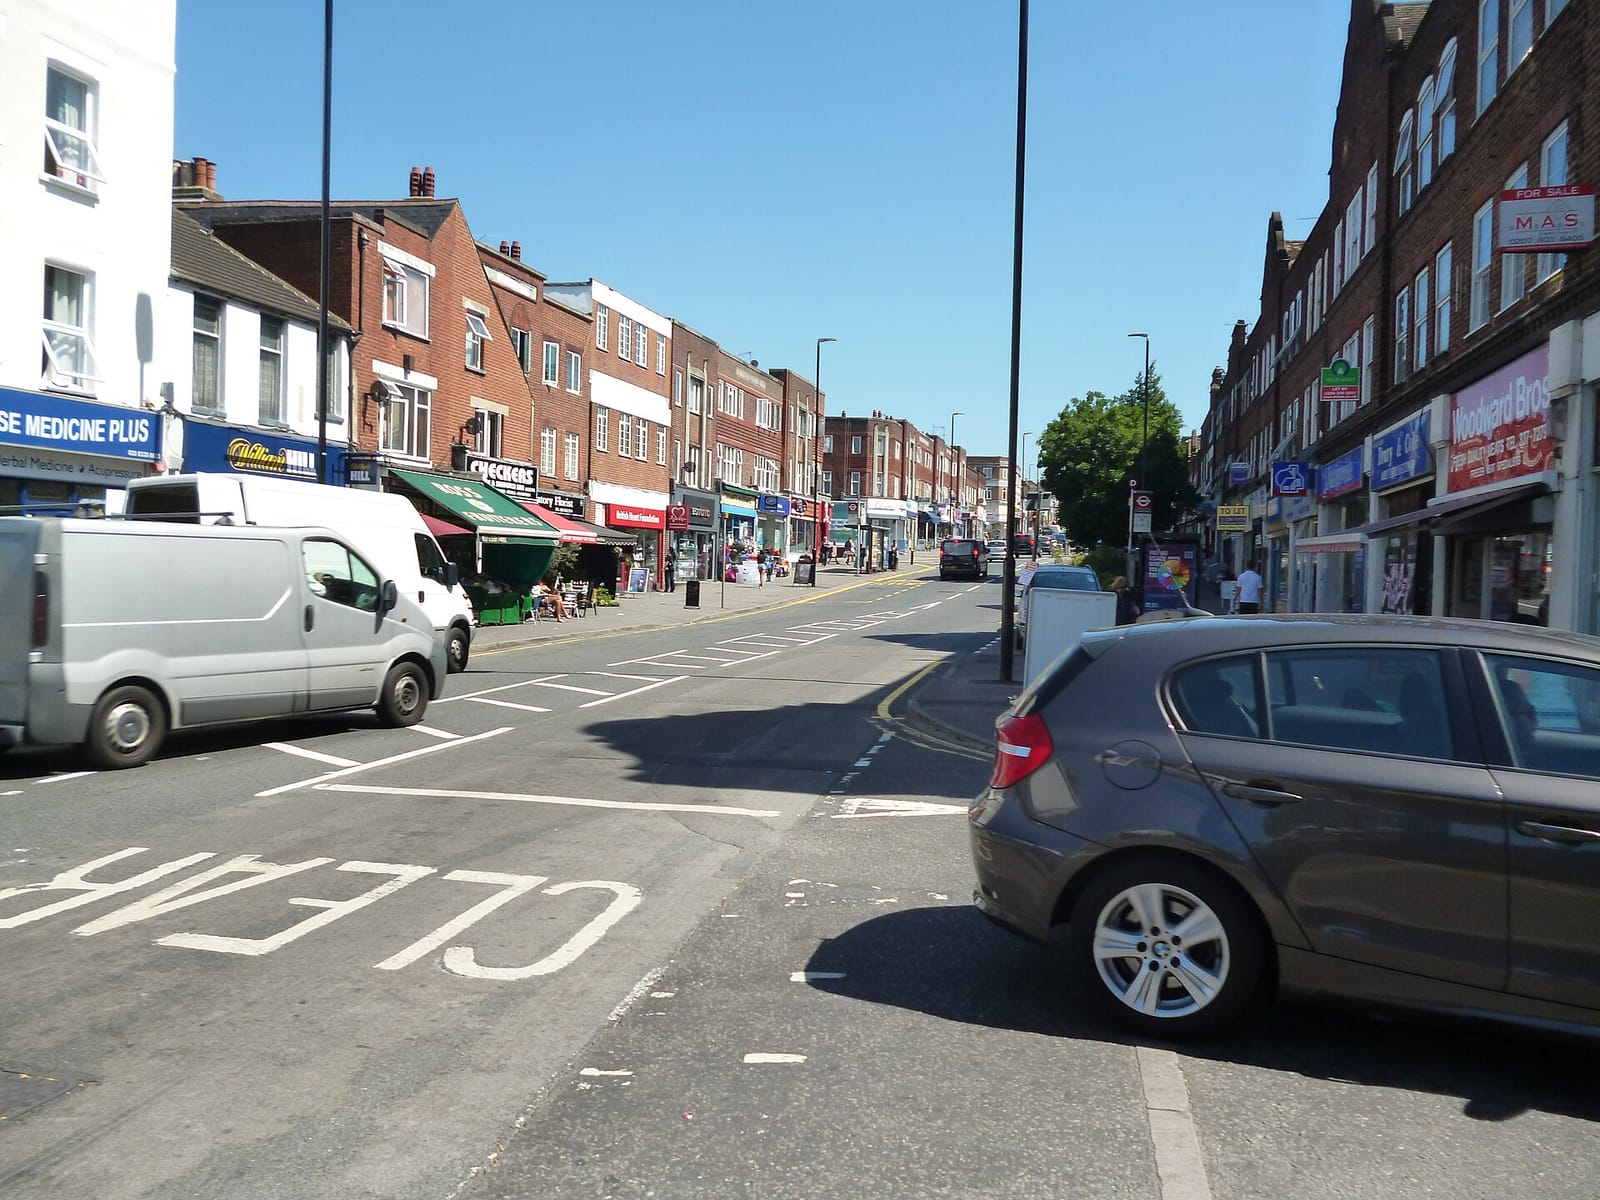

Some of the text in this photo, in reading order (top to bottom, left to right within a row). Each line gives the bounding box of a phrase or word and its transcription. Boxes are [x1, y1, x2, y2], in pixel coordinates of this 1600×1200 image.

[1516, 186, 1579, 199] FOR SALE
[1452, 375, 1551, 444] Woodward Bros
[25, 414, 106, 442] MEDICINE
[109, 418, 149, 443] PLUS
[0, 455, 144, 480] erbal Medicine Acupressure
[228, 438, 318, 476] William HILL
[350, 470, 370, 482] HILL
[470, 460, 534, 485] CHECKERS
[430, 482, 483, 499] ROSS
[1221, 507, 1245, 515] TO LET
